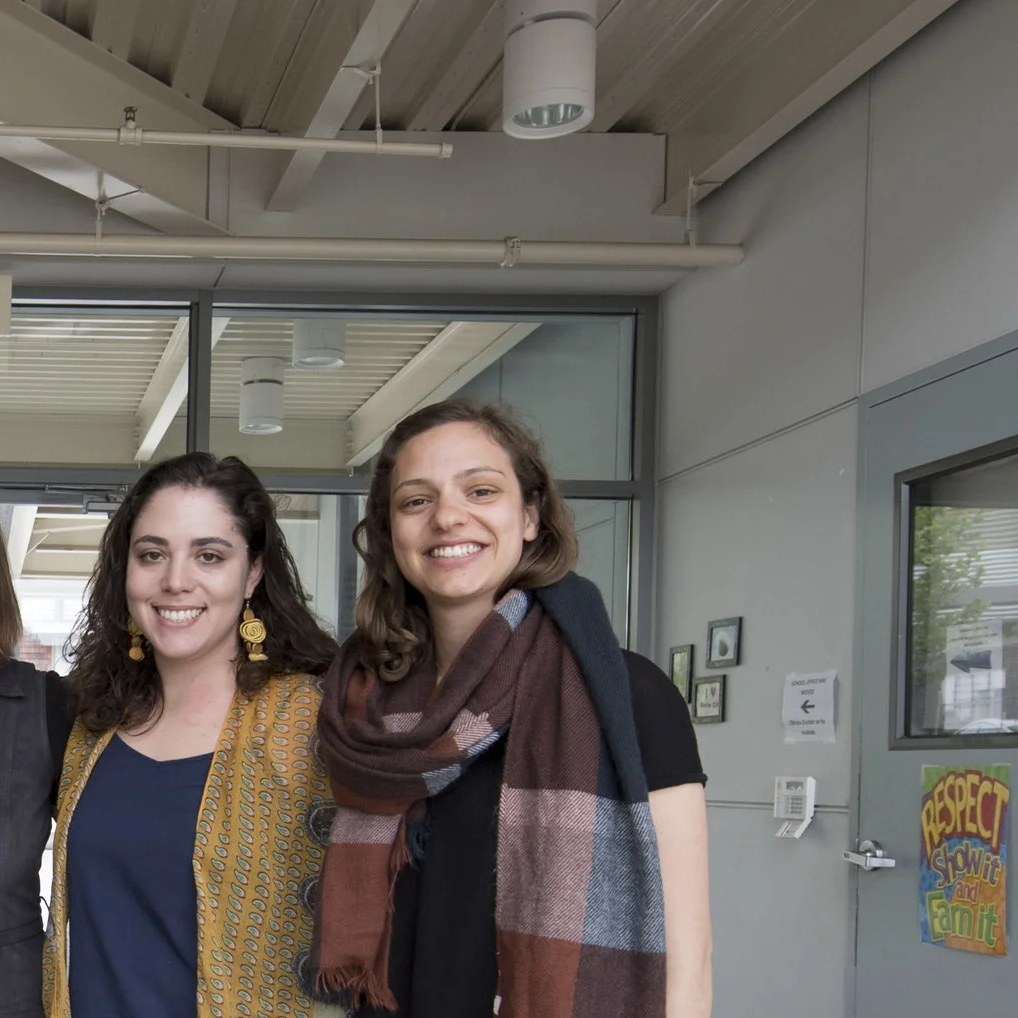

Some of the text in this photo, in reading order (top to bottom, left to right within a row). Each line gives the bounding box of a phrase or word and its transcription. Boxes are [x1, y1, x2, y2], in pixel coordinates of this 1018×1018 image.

[921, 773, 1009, 864] RESPECT
[956, 880, 980, 904] and
[983, 853, 1001, 887] it
[927, 890, 999, 948] Earn it
